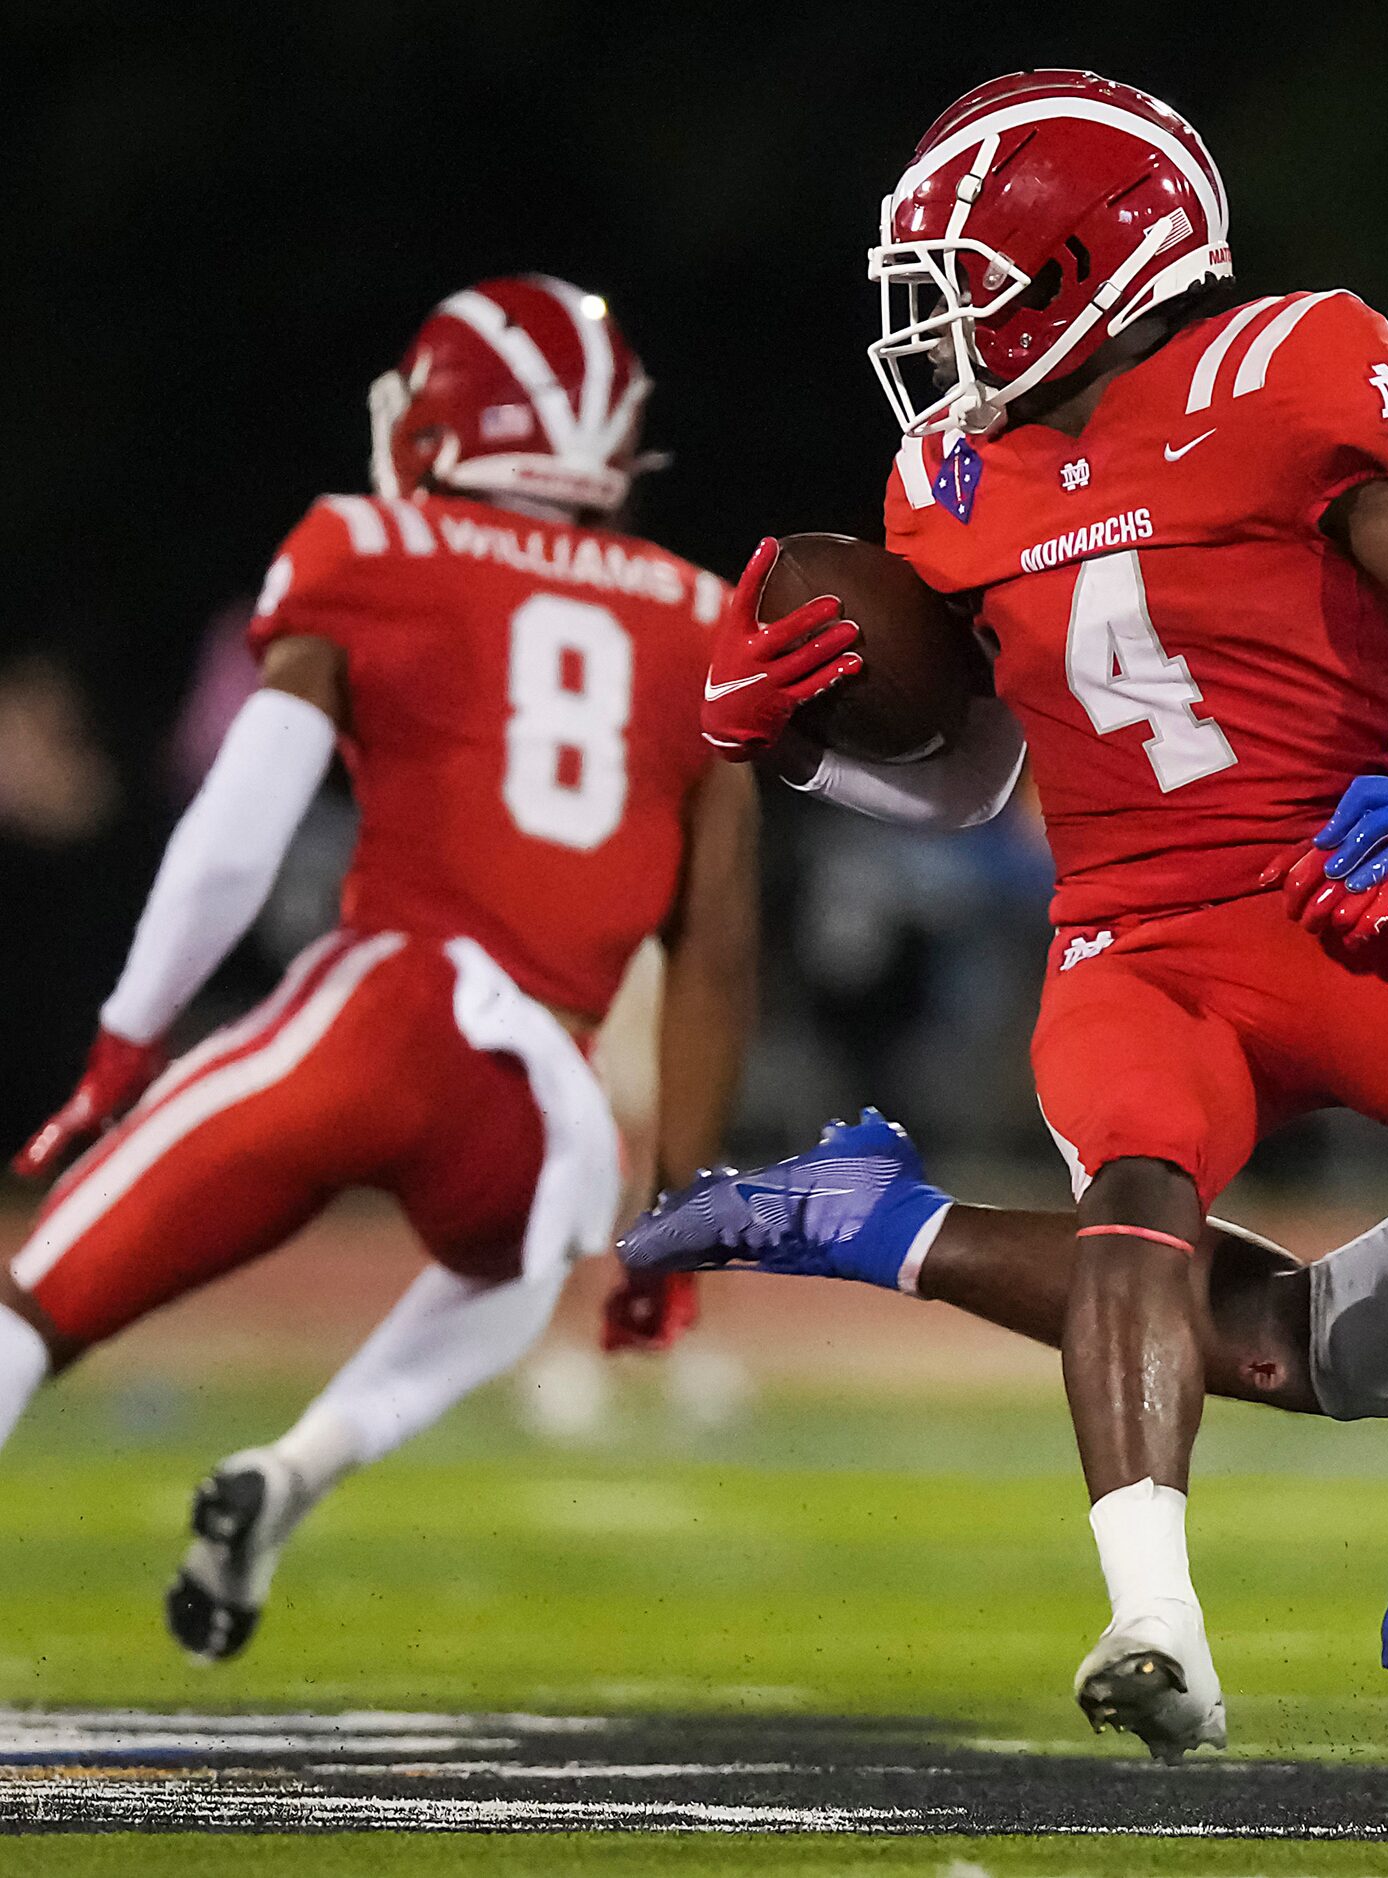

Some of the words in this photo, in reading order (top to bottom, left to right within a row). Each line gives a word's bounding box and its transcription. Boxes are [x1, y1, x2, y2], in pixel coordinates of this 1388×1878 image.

[440, 515, 684, 604] WILLIAMS
[1020, 508, 1153, 573] MONARCHS
[502, 591, 634, 854] 8
[1065, 549, 1239, 793] 4
